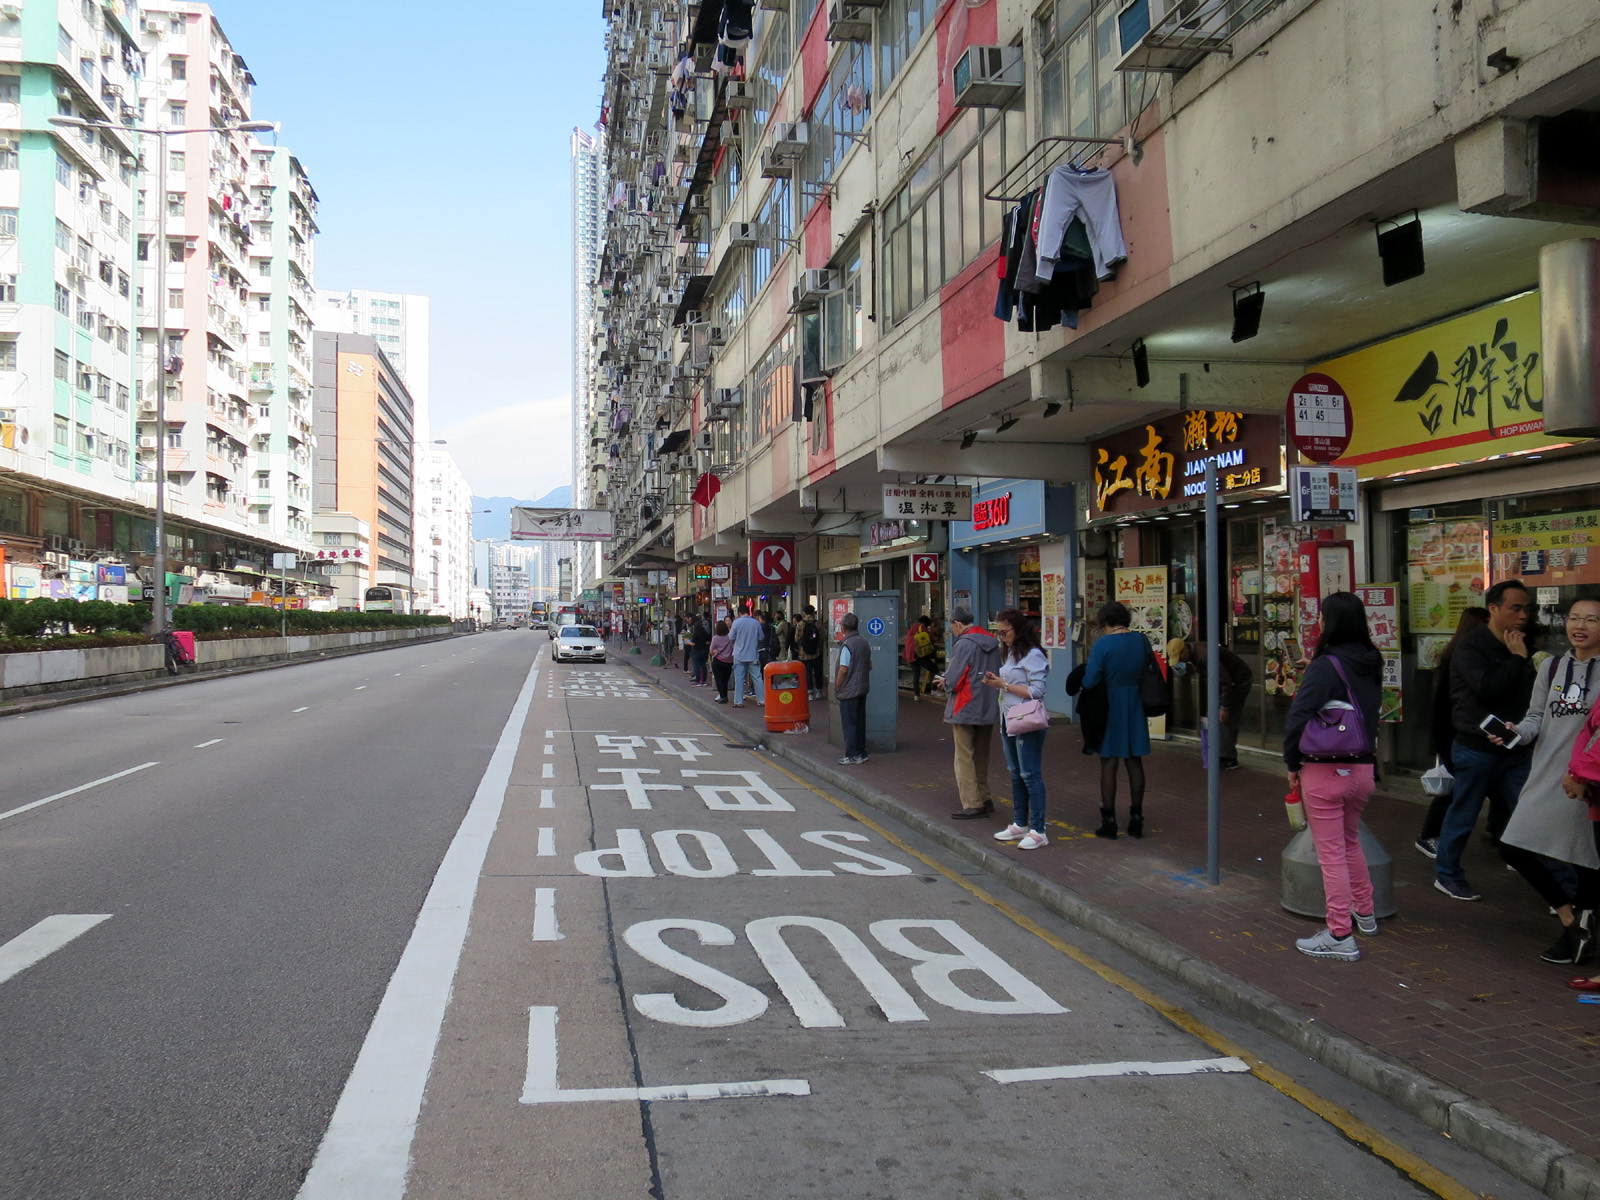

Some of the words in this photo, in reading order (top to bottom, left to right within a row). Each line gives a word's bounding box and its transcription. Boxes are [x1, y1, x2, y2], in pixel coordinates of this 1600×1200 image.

[1299, 395, 1307, 407] 2E
[1315, 396, 1323, 407] 6C
[1332, 397, 1340, 408] 6F
[1299, 410, 1308, 421] 41
[1316, 411, 1324, 422] 45
[1500, 426, 1518, 436] HOP
[1095, 425, 1174, 511] 江南
[1226, 467, 1261, 489] 第二分店
[1301, 486, 1311, 495] 6F
[1330, 486, 1339, 495] 6C
[760, 546, 791, 580] K
[916, 557, 936, 579] K
[1118, 574, 1144, 594] 江南
[574, 828, 913, 877] STOP
[622, 915, 1071, 1028] BUS
